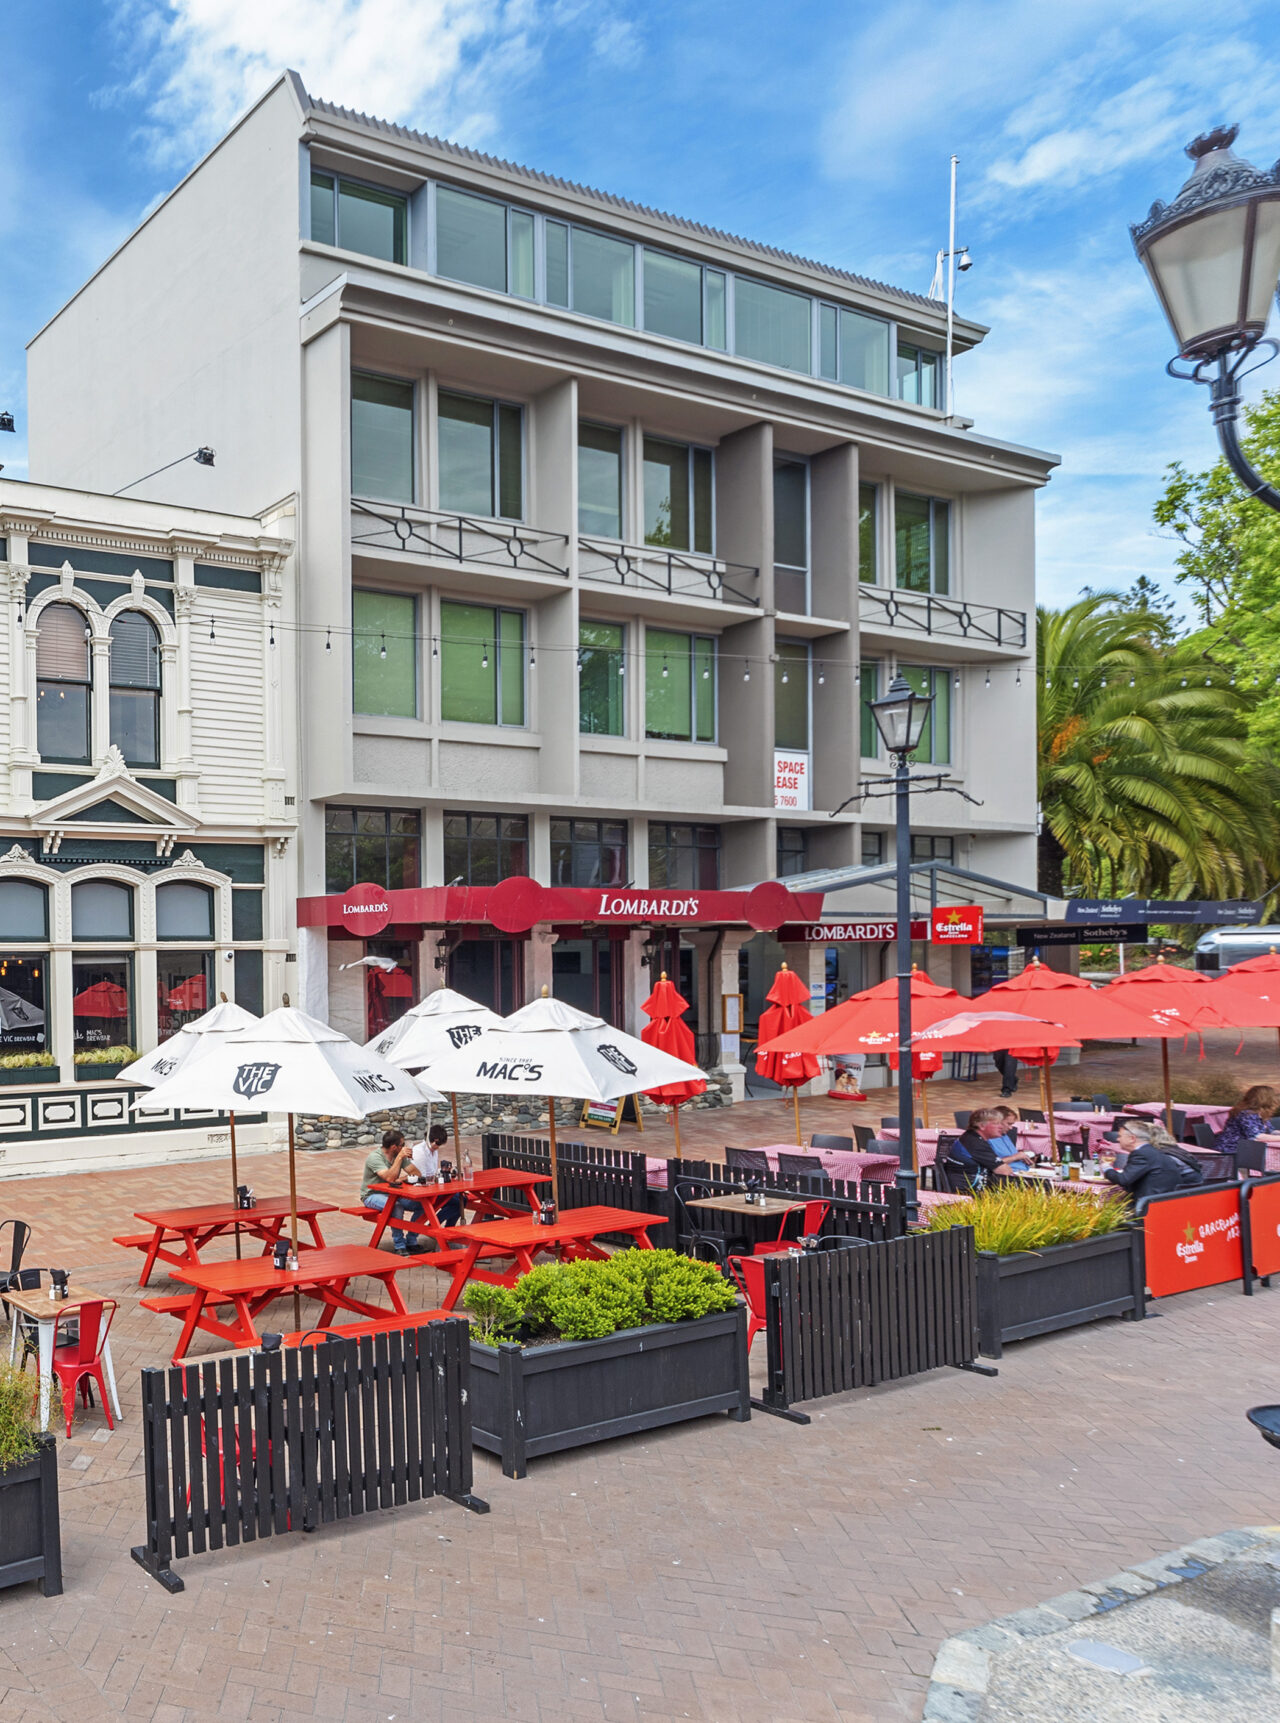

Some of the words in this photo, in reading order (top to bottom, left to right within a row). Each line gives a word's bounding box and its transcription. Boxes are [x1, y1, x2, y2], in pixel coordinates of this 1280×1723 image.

[777, 760, 805, 775] SPACE
[773, 776, 799, 790] EASE
[780, 795, 798, 807] 7600
[343, 902, 388, 914] LOMBARDI'S
[598, 894, 699, 916] LOMBARDI'S
[805, 923, 895, 940] LOMBARDI'S
[935, 922, 972, 932] Estrella
[1083, 927, 1128, 937] Sotheby's
[243, 1066, 275, 1079] THE
[476, 1061, 544, 1081] MAC'S
[238, 1077, 267, 1092] VIC
[1176, 1240, 1204, 1257] Estrella
